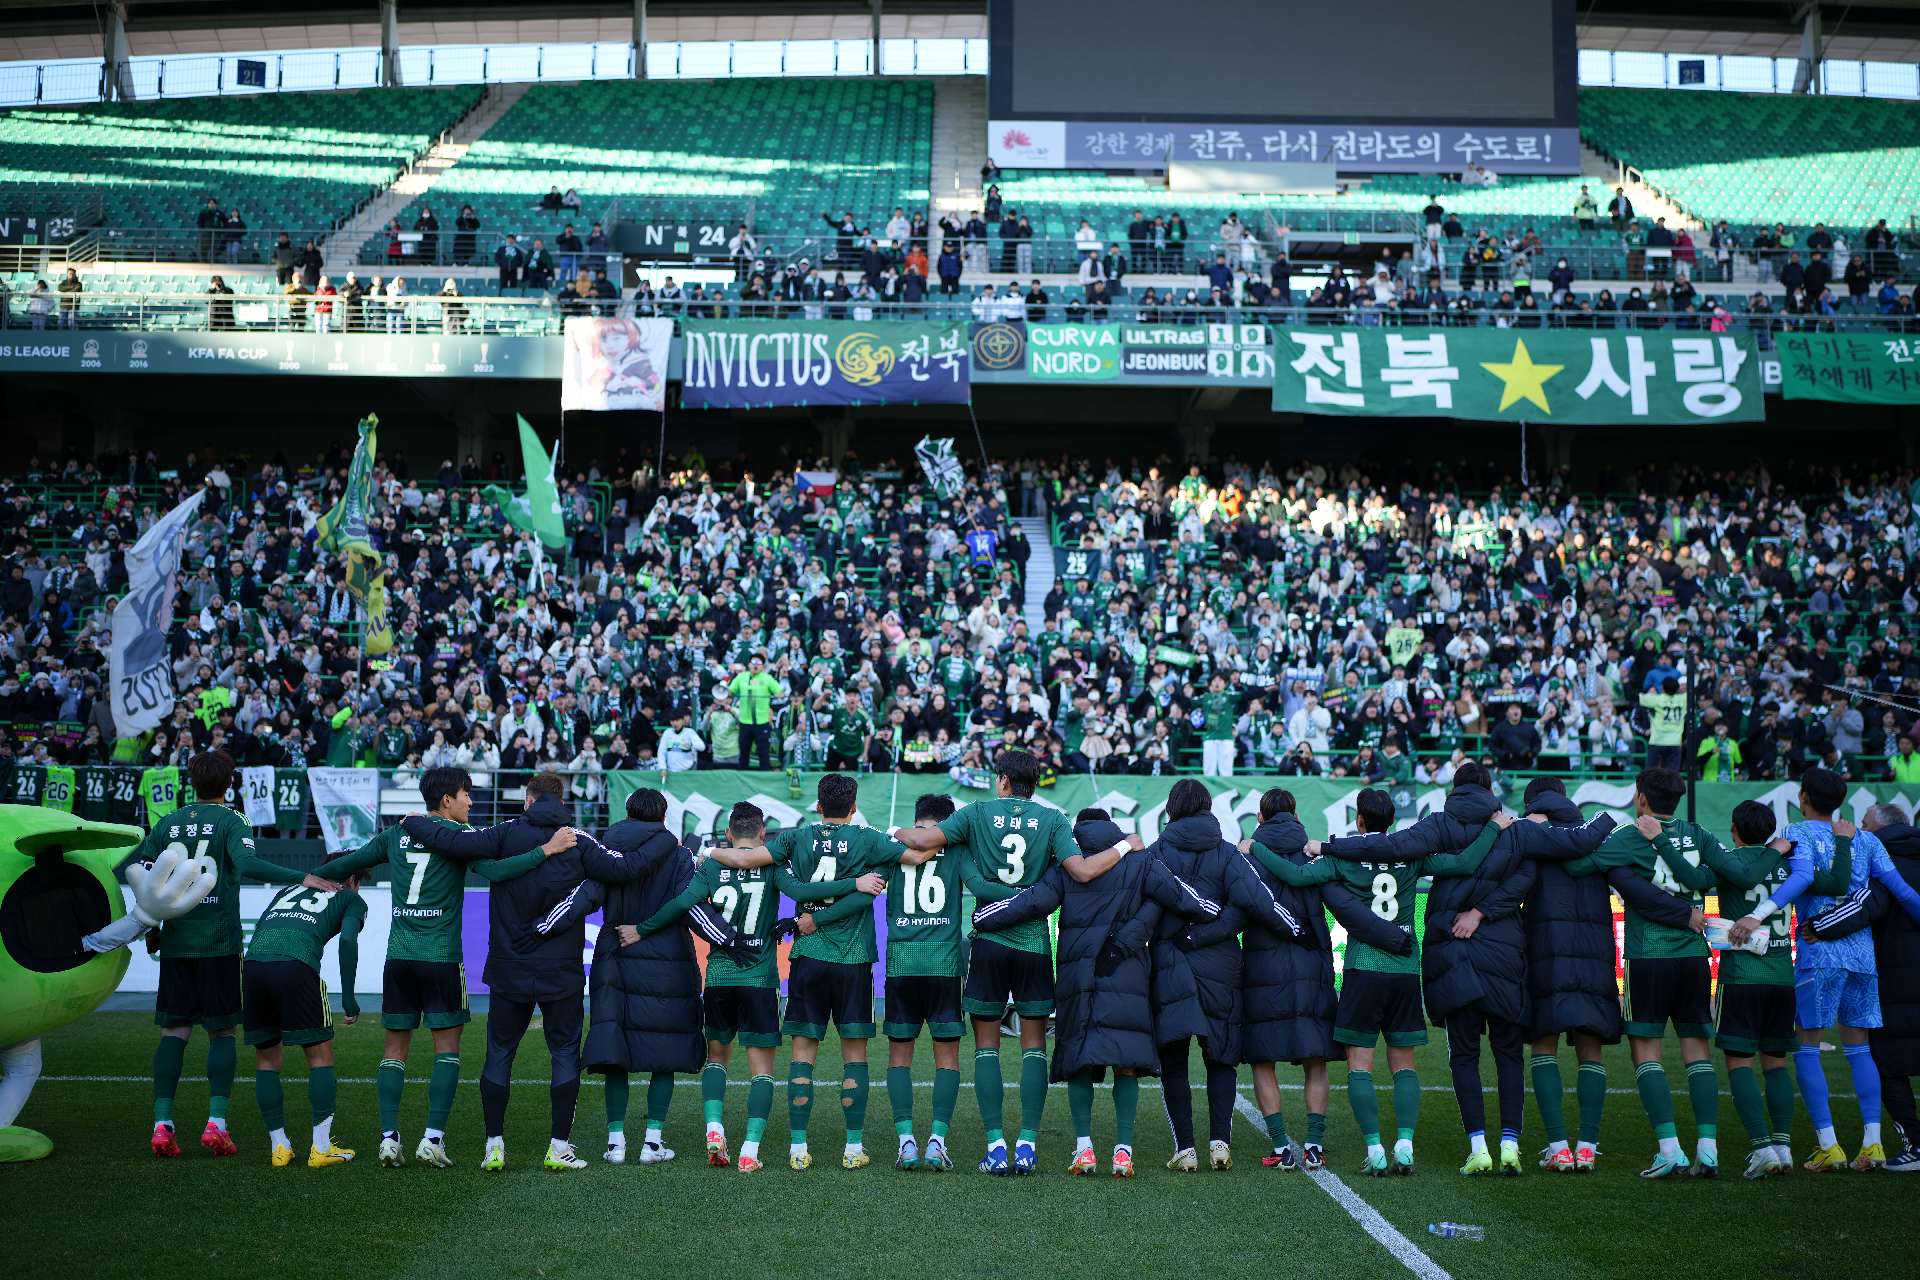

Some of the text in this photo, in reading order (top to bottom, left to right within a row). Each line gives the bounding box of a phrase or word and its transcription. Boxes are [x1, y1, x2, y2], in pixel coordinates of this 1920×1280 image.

[1085, 130, 1552, 163] 강한 경제 전주, 다시 전라도의 수도로!
[699, 226, 726, 246] 24
[1031, 328, 1117, 347] CURVA
[1126, 330, 1206, 345] ULTRAS
[15, 346, 70, 357] LEAGUE
[188, 347, 269, 360] KFA FA CUP
[685, 331, 832, 388] INVICTUS
[898, 330, 967, 382] 전북
[1125, 352, 1206, 370] JEONBUK
[81, 359, 102, 368] 2006
[129, 359, 148, 368] 2016
[1032, 351, 1102, 375] NORD
[1290, 332, 1459, 408] 전북
[1574, 336, 1748, 417] 사랑
[17, 777, 36, 797] 26
[47, 781, 69, 801] 26
[86, 778, 105, 798] 26
[114, 781, 135, 802] 26
[151, 783, 175, 803] 26
[279, 785, 300, 806] 26
[169, 823, 214, 838] 홍정호
[993, 815, 1039, 830] 정태욱
[998, 833, 1027, 885] 3
[405, 851, 432, 905] 7
[901, 860, 946, 914] 16
[1371, 872, 1399, 922] 8
[402, 908, 443, 917] HYUNDAI
[712, 882, 766, 935] 27
[911, 917, 950, 925] HYUNDAI
